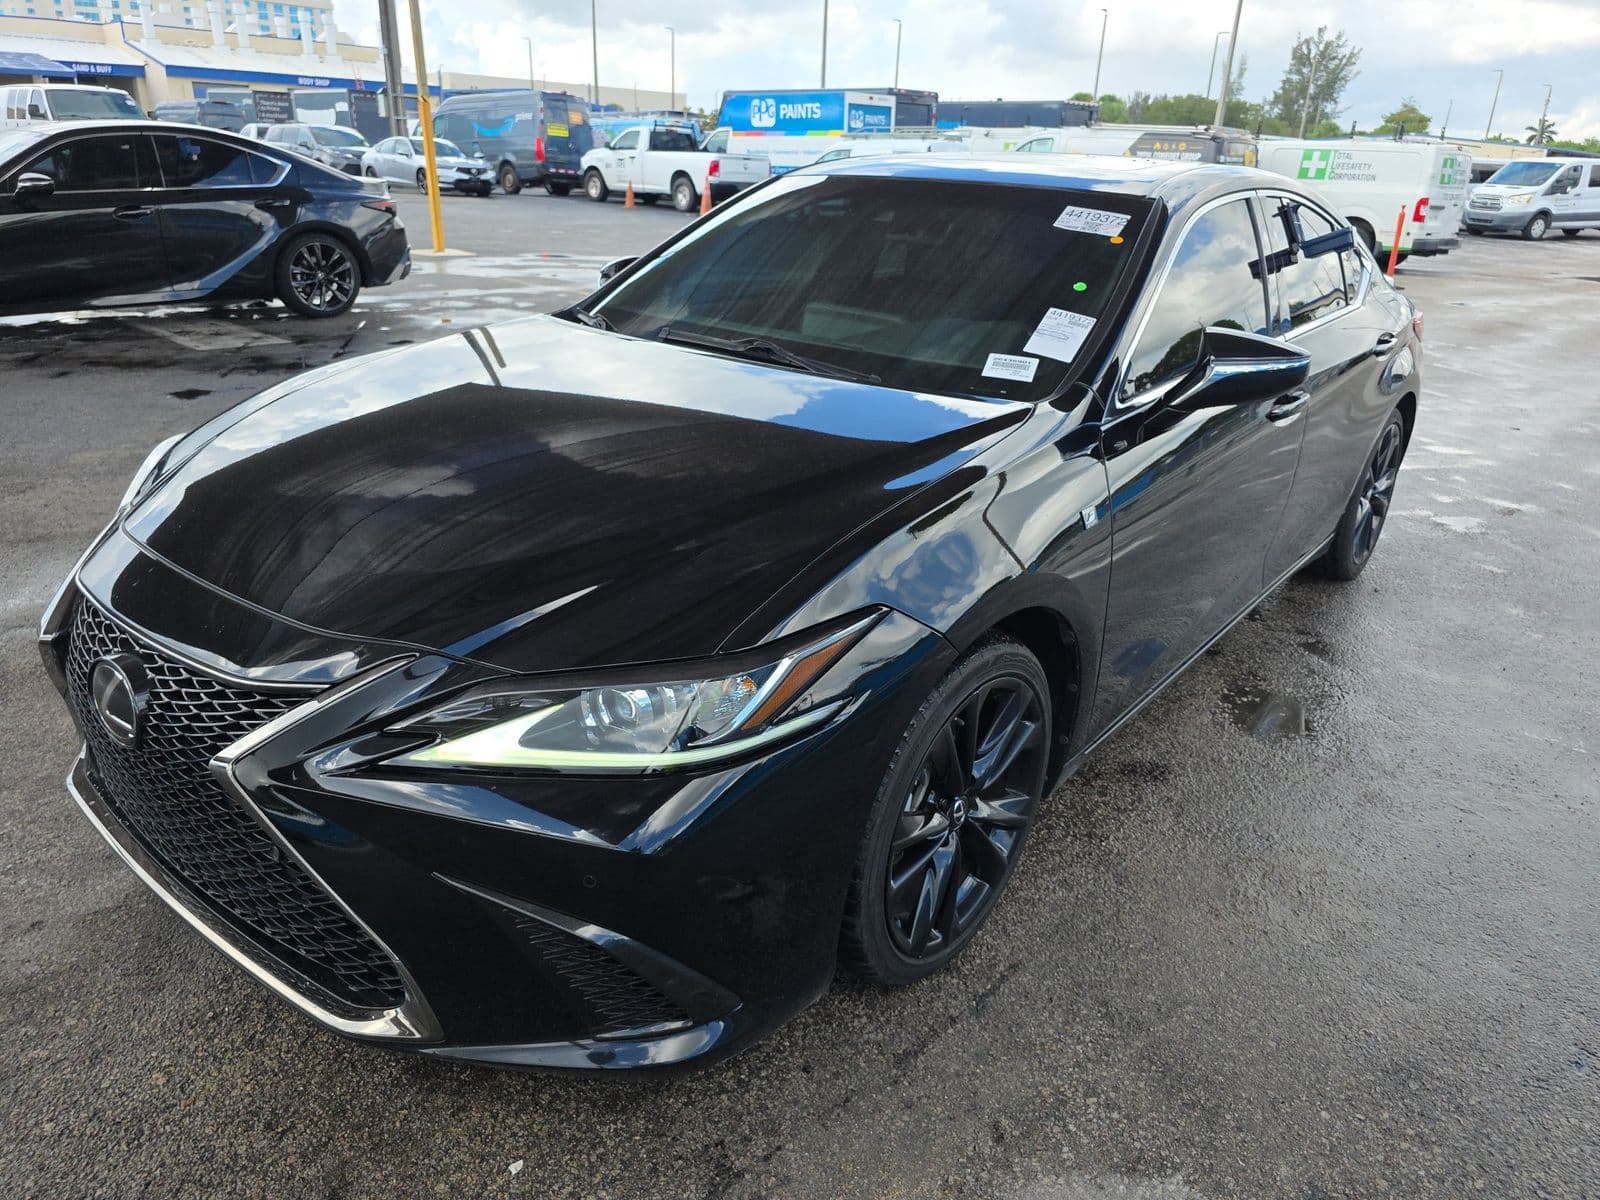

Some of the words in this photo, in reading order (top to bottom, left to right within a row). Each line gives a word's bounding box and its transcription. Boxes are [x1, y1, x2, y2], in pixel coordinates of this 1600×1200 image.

[297, 77, 314, 86] BODY
[315, 78, 331, 86] SHOP
[780, 102, 821, 119] PAINTS
[1331, 162, 1373, 171] LIFESAFETY
[1328, 170, 1377, 182] CORPORATION
[1065, 210, 1130, 225] 4419372
